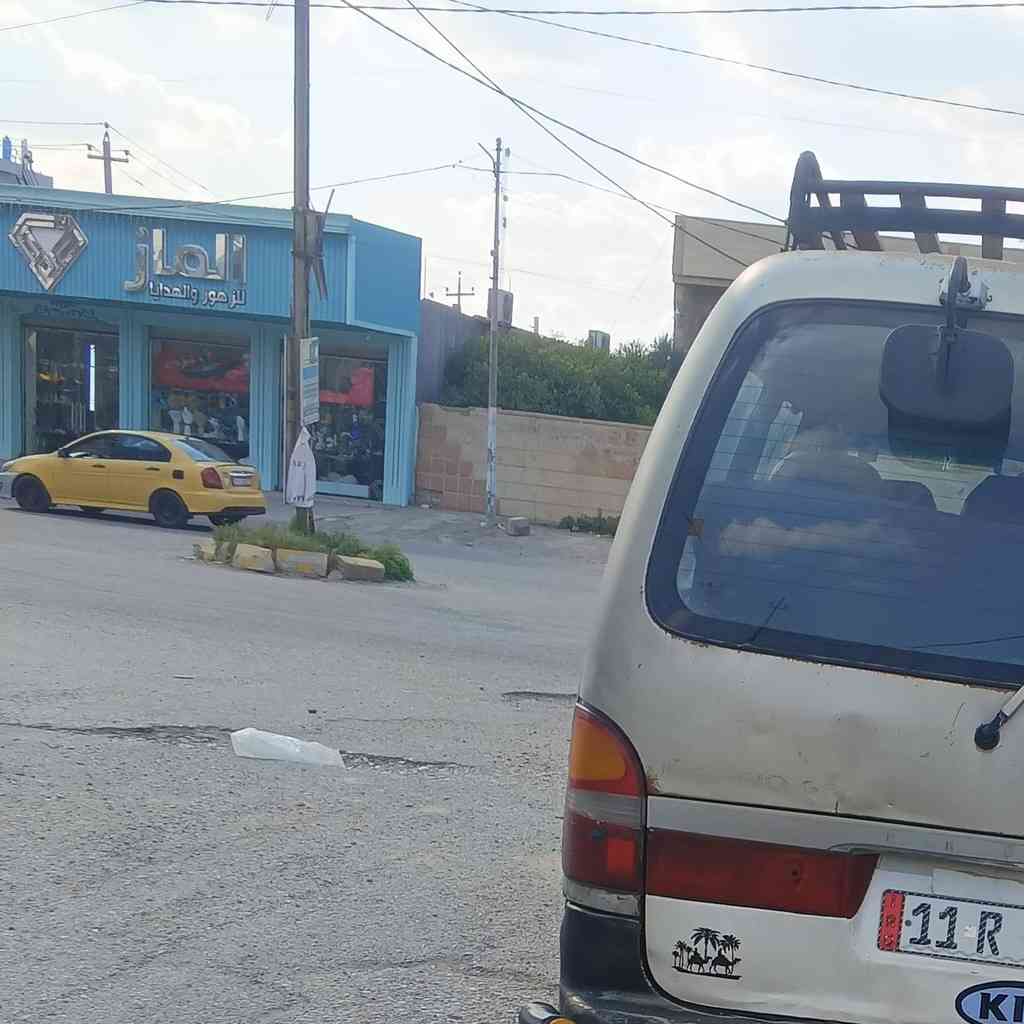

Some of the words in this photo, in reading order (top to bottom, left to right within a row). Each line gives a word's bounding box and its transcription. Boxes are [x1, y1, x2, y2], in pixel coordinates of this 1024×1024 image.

[202, 288, 245, 307] للزهور
[908, 902, 958, 950] 11
[976, 910, 1003, 956] R
